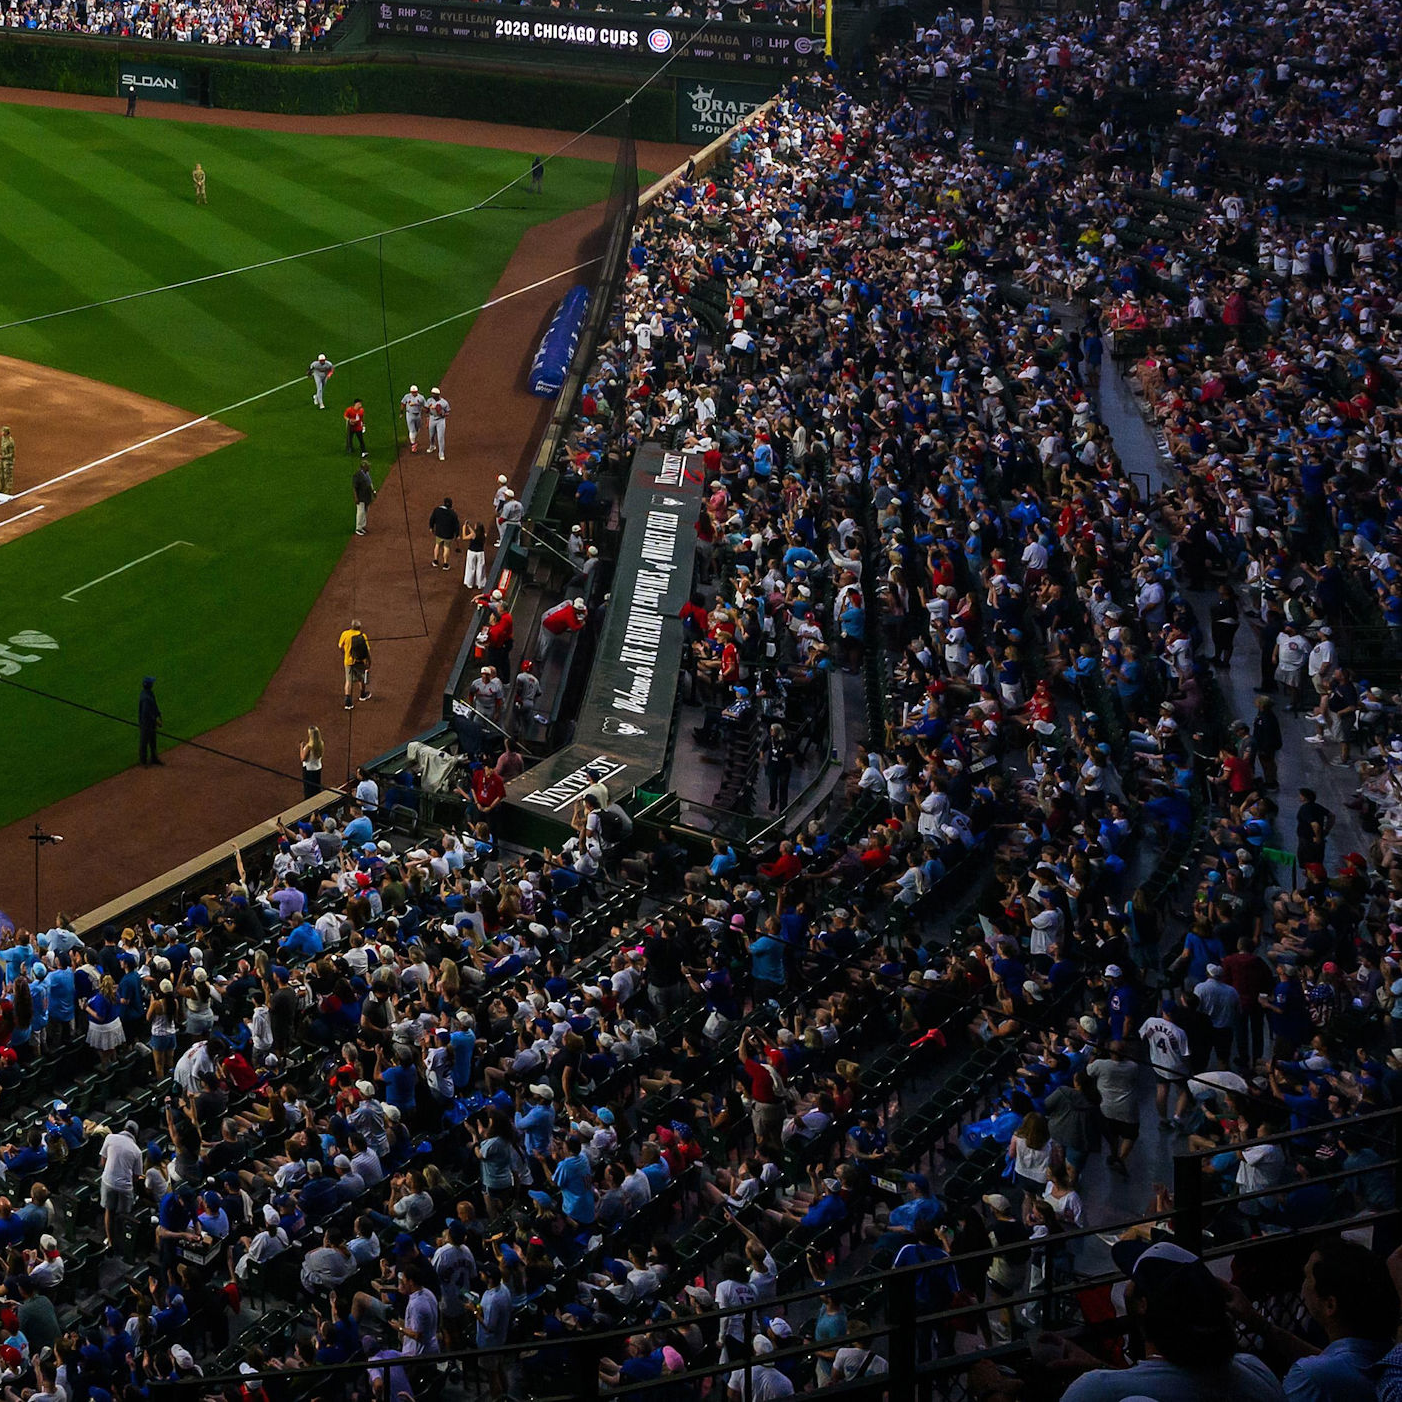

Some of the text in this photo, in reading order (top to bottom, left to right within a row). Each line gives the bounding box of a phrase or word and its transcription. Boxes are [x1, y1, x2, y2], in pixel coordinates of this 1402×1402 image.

[398, 7, 417, 18] RHP
[496, 19, 530, 37] 2026
[534, 23, 596, 43] CHICAGO
[599, 28, 638, 46] CUBS
[769, 38, 789, 48] LHP
[121, 74, 176, 89] SLOAN
[692, 97, 762, 113] DRAFT
[700, 110, 747, 124] KIN
[692, 124, 727, 135] SPORT
[647, 511, 679, 533] FIELD
[641, 529, 676, 561] WRIGLEY
[624, 606, 663, 648] FRIENDLY
[619, 646, 657, 666] THE
[612, 676, 651, 714] Welcome
[521, 755, 618, 807] WINTRST
